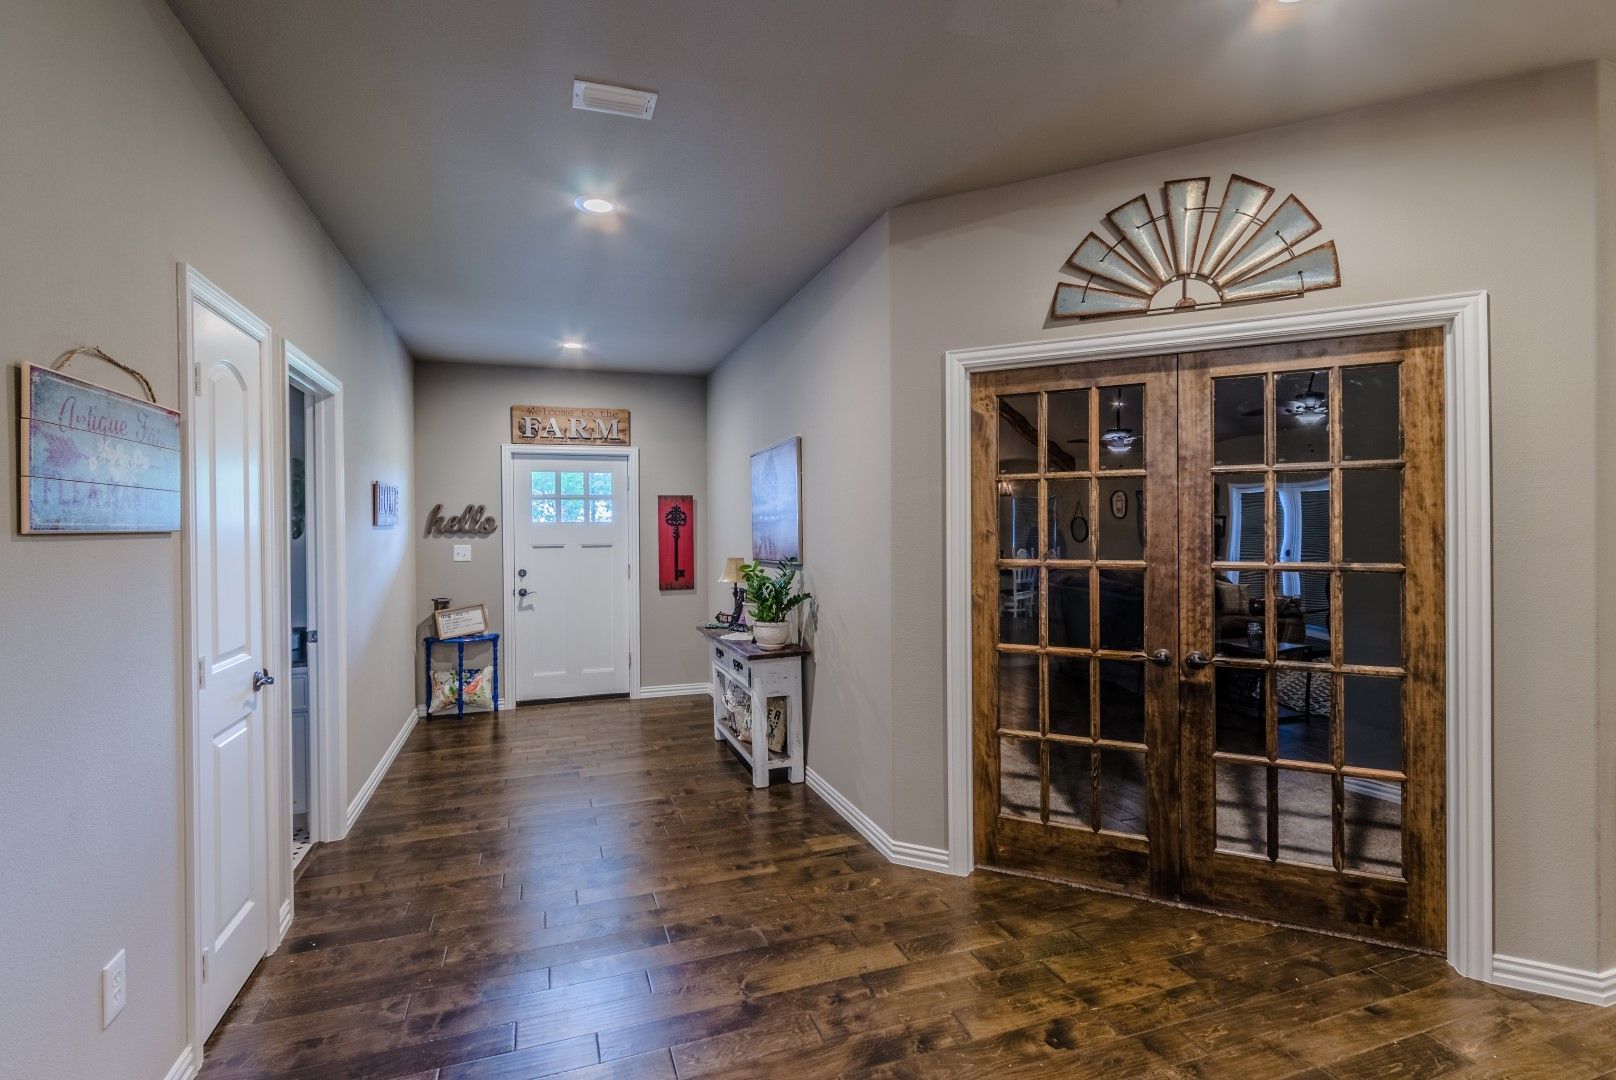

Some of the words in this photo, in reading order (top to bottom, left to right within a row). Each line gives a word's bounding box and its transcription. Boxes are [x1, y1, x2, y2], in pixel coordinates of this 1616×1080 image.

[58, 396, 128, 443] Antique
[527, 407, 574, 417] Welcome
[581, 409, 594, 418] to
[600, 409, 619, 419] the
[520, 416, 621, 440] FARM
[423, 503, 497, 538] hello
